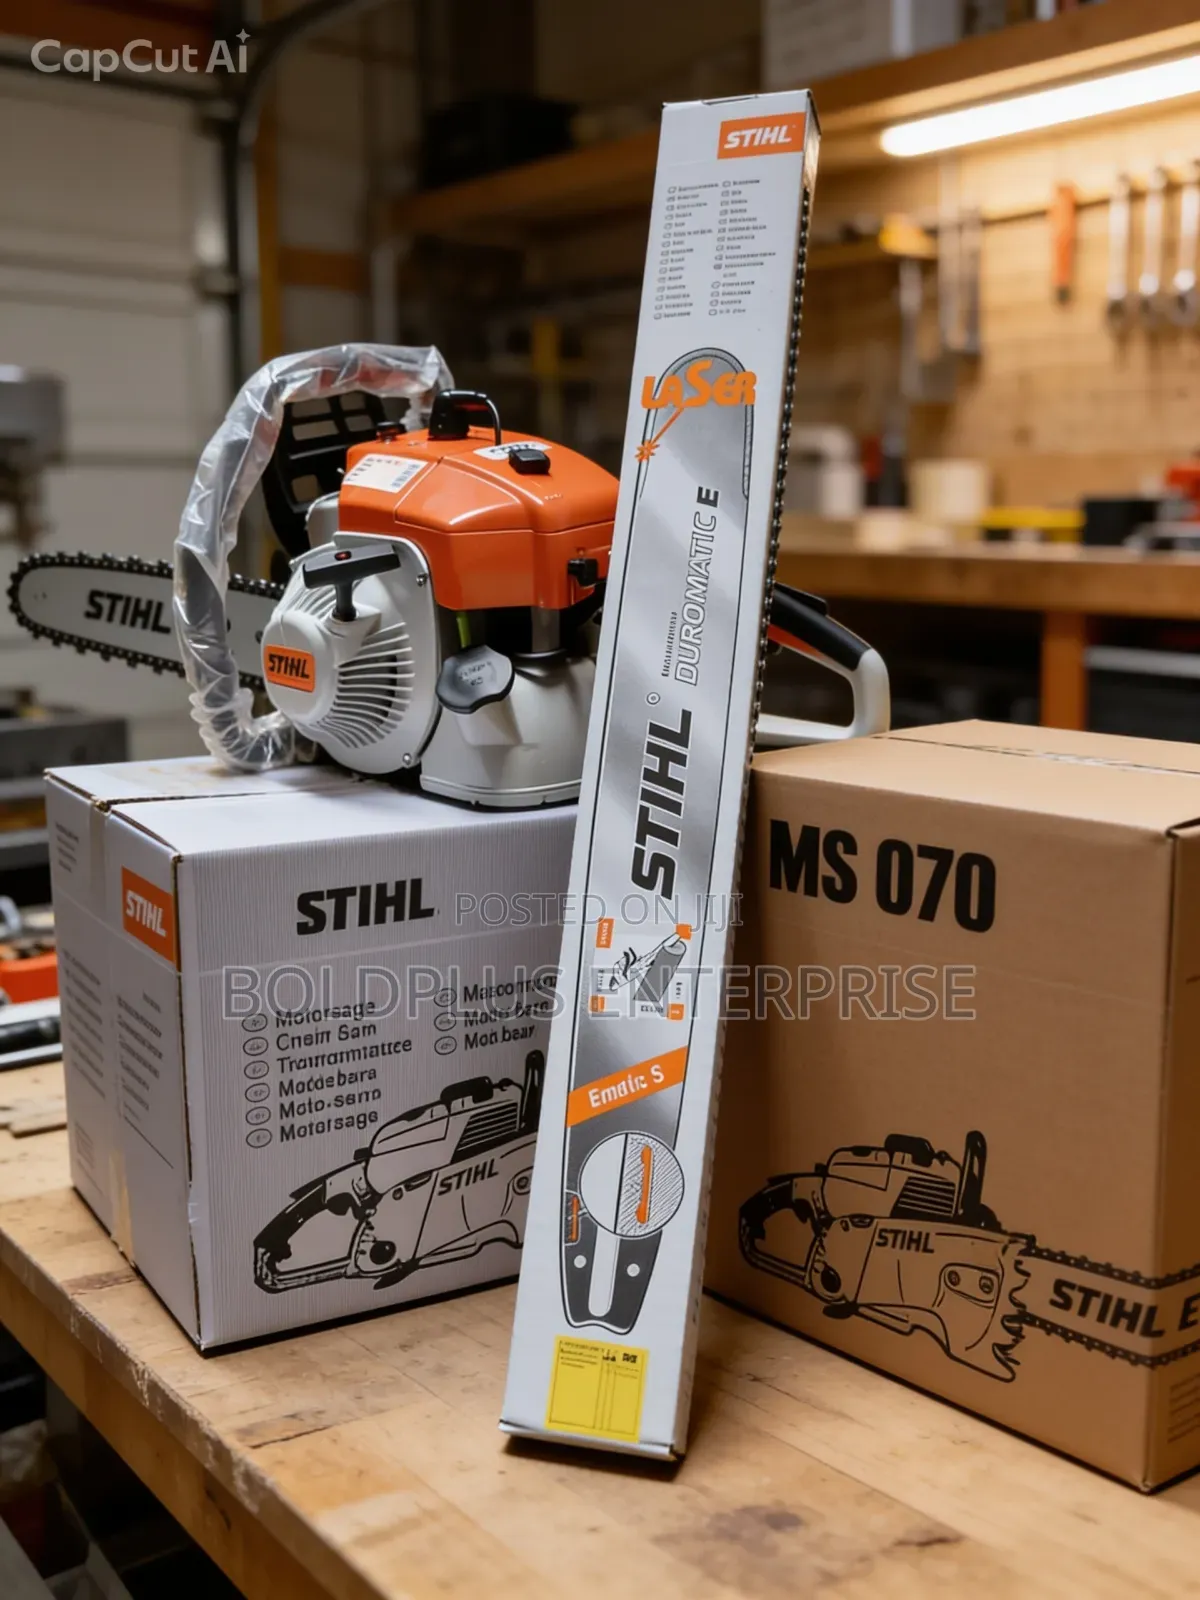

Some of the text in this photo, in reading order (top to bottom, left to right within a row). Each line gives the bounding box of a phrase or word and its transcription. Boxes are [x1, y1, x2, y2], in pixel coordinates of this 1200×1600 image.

[724, 124, 793, 149] STIHL
[675, 485, 720, 686] DUROMATIC E
[84, 589, 172, 634] STIHL
[267, 652, 311, 680] STIHL
[630, 708, 692, 901] STIHL
[769, 818, 997, 934] MS 070
[125, 889, 168, 938] STIHL
[296, 877, 435, 936] STIHL
[650, 1063, 665, 1084] S
[438, 1158, 501, 1197] STIHL
[875, 1227, 935, 1255] STIHL
[1049, 1277, 1166, 1338] STIHL
